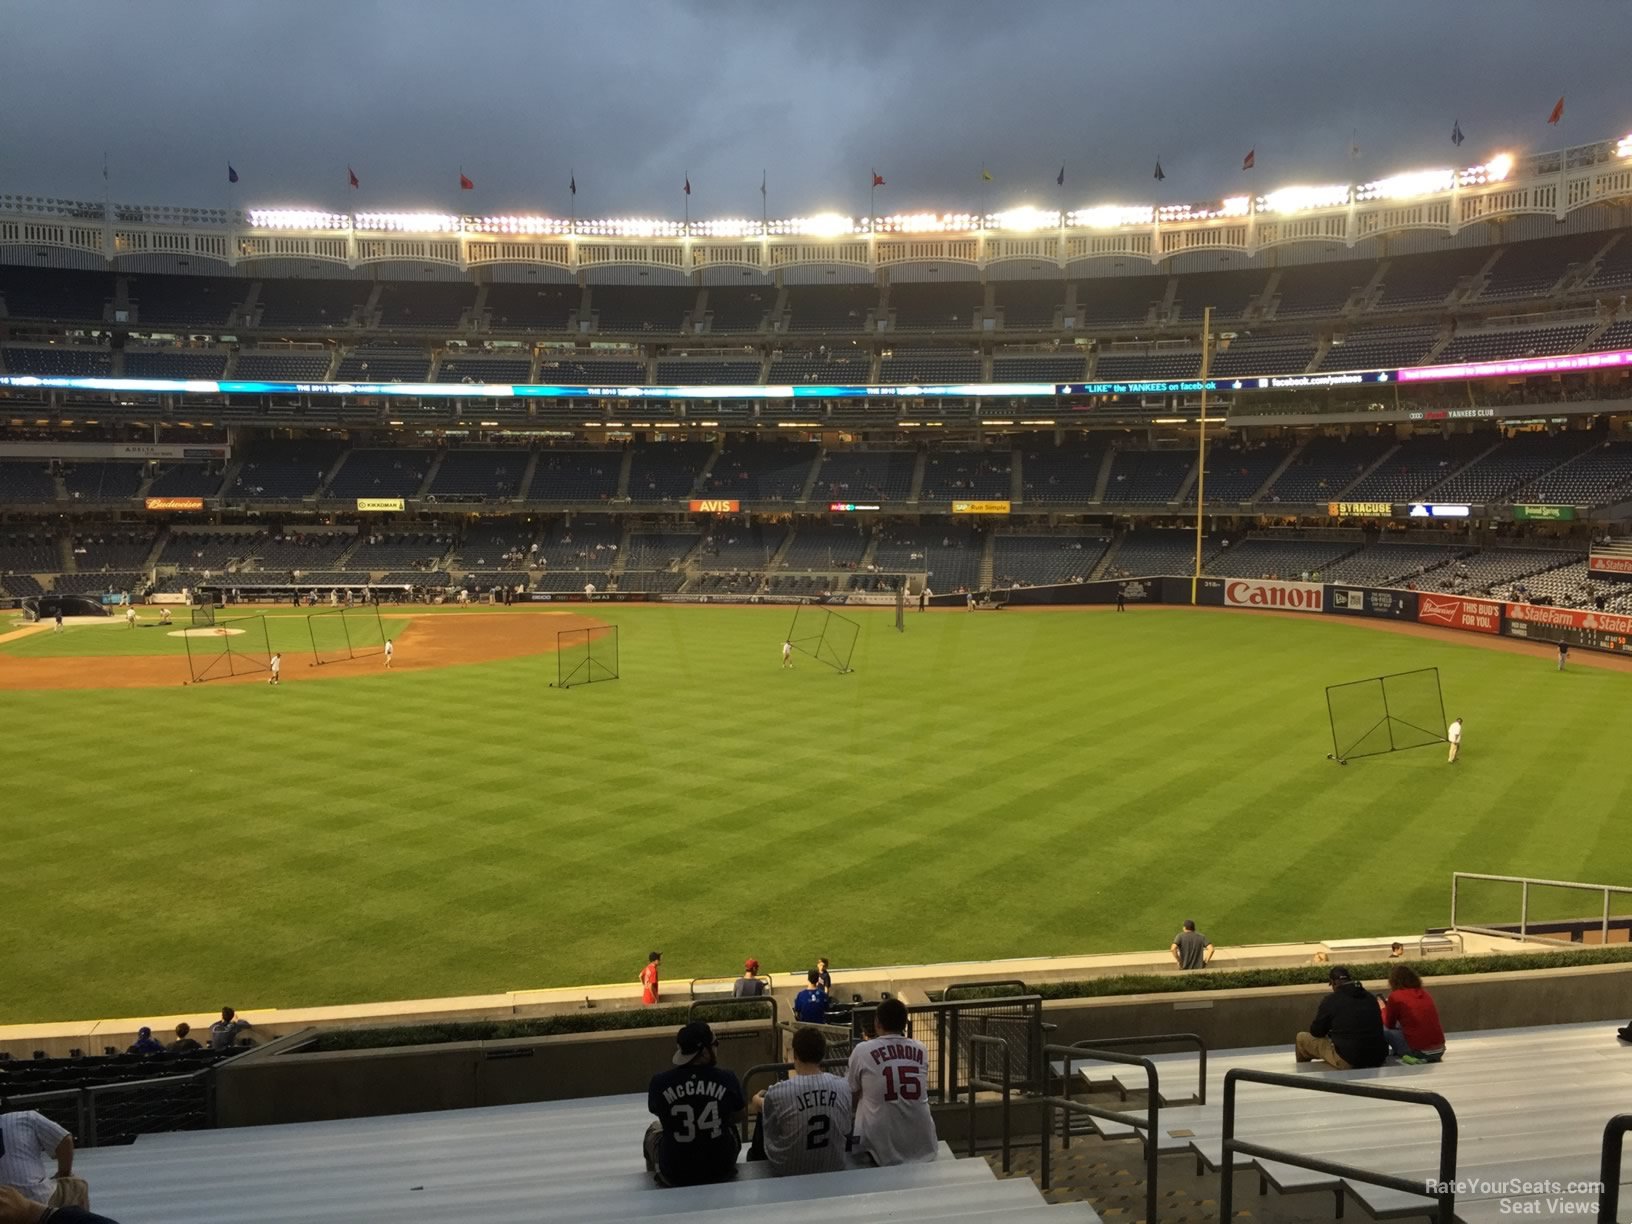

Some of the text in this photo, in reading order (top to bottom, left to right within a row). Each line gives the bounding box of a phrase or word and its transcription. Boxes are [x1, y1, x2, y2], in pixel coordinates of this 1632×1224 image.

[1113, 384, 1126, 392] the
[1128, 383, 1167, 392] YANKEES
[1448, 410, 1477, 418] YANKEES
[1477, 409, 1494, 417] CLUB
[146, 499, 203, 510] Budweiser
[700, 501, 731, 512] AVIS
[1339, 503, 1392, 513] SYRACUSE
[1226, 582, 1322, 609] Canon
[1423, 603, 1456, 615] Budweiser
[1462, 602, 1500, 617] THIS BUD'S
[1461, 614, 1492, 628] FOR YOU.
[870, 1044, 923, 1065] PEDROIA
[882, 1066, 921, 1101] 15
[797, 1090, 837, 1112] JETER
[671, 1101, 722, 1143] 34
[807, 1114, 830, 1150] 2
